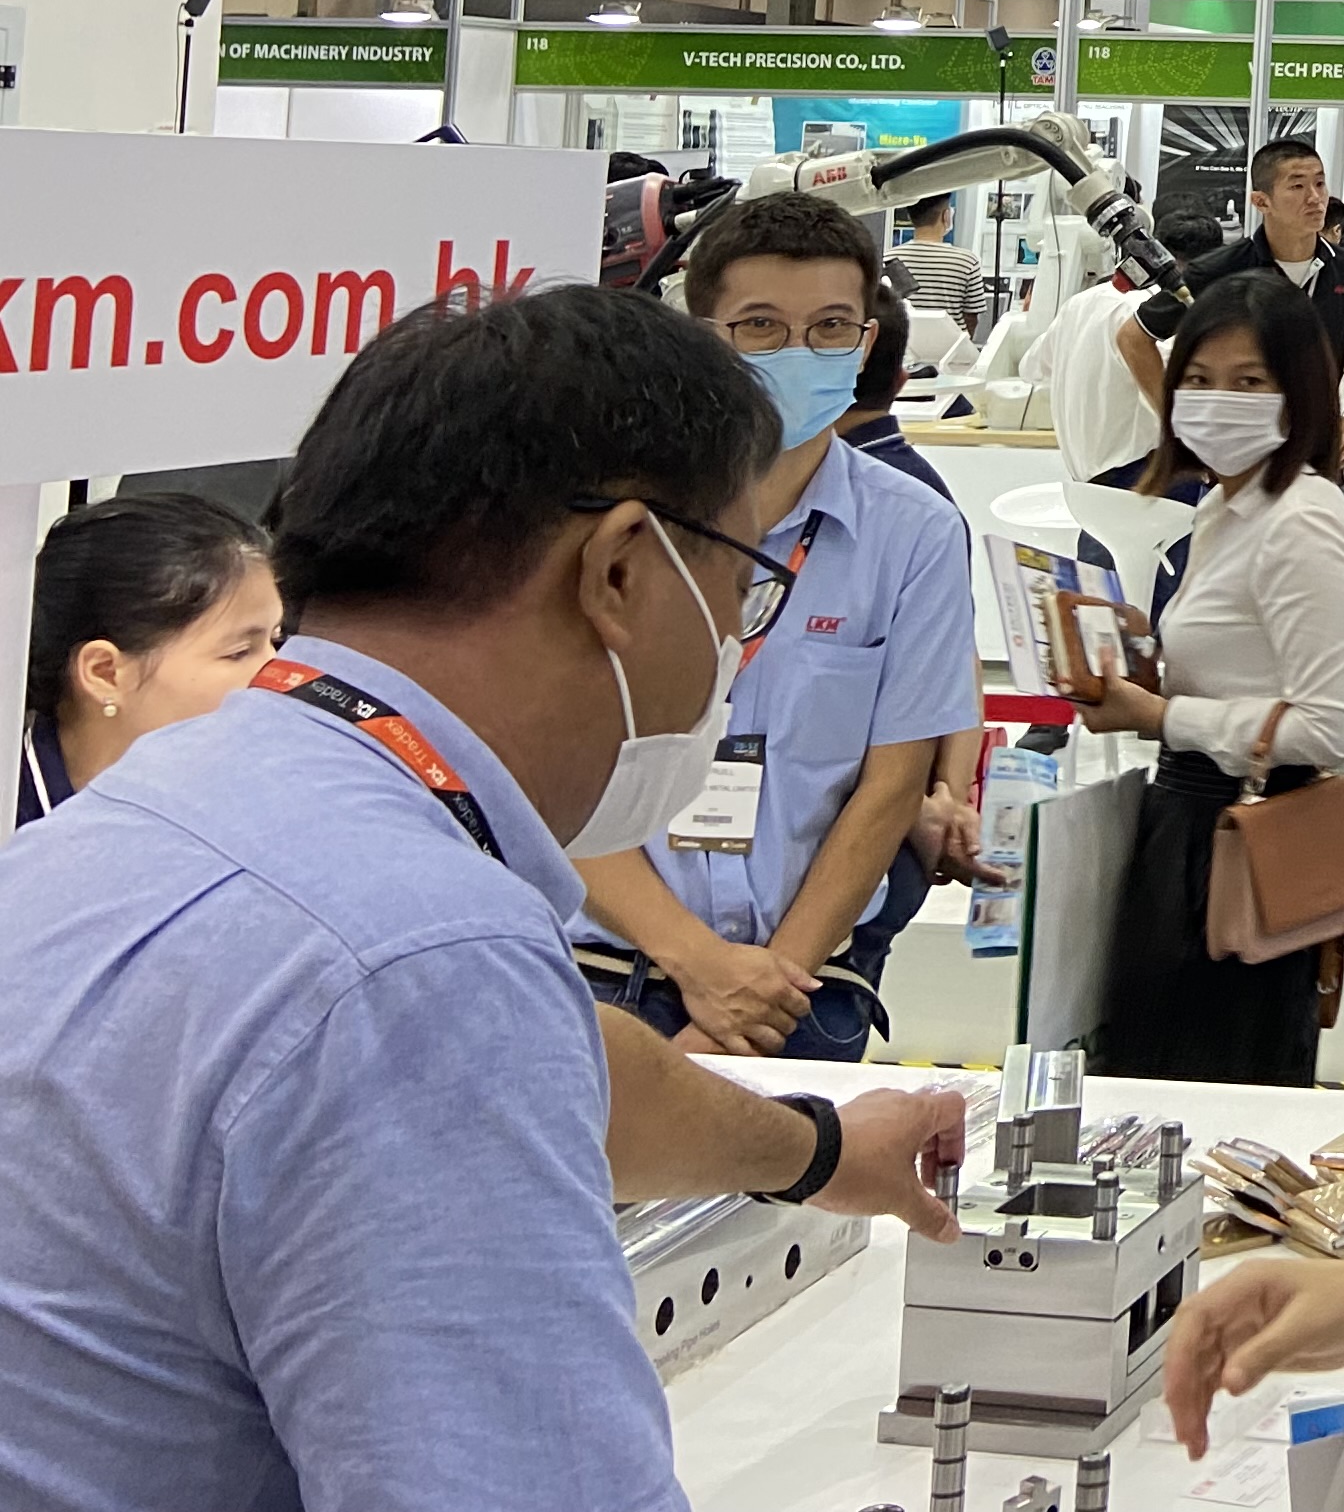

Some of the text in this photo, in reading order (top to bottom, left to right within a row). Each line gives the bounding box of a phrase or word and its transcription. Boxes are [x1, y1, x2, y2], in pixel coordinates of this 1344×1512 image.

[230, 43, 250, 59] OF
[254, 44, 348, 60] MACHINERY
[352, 45, 433, 62] INDUSTRY
[683, 51, 905, 71] V-TECH PRECISION CO., LTD.
[812, 167, 848, 187] ABB
[384, 718, 428, 765] Tradex
